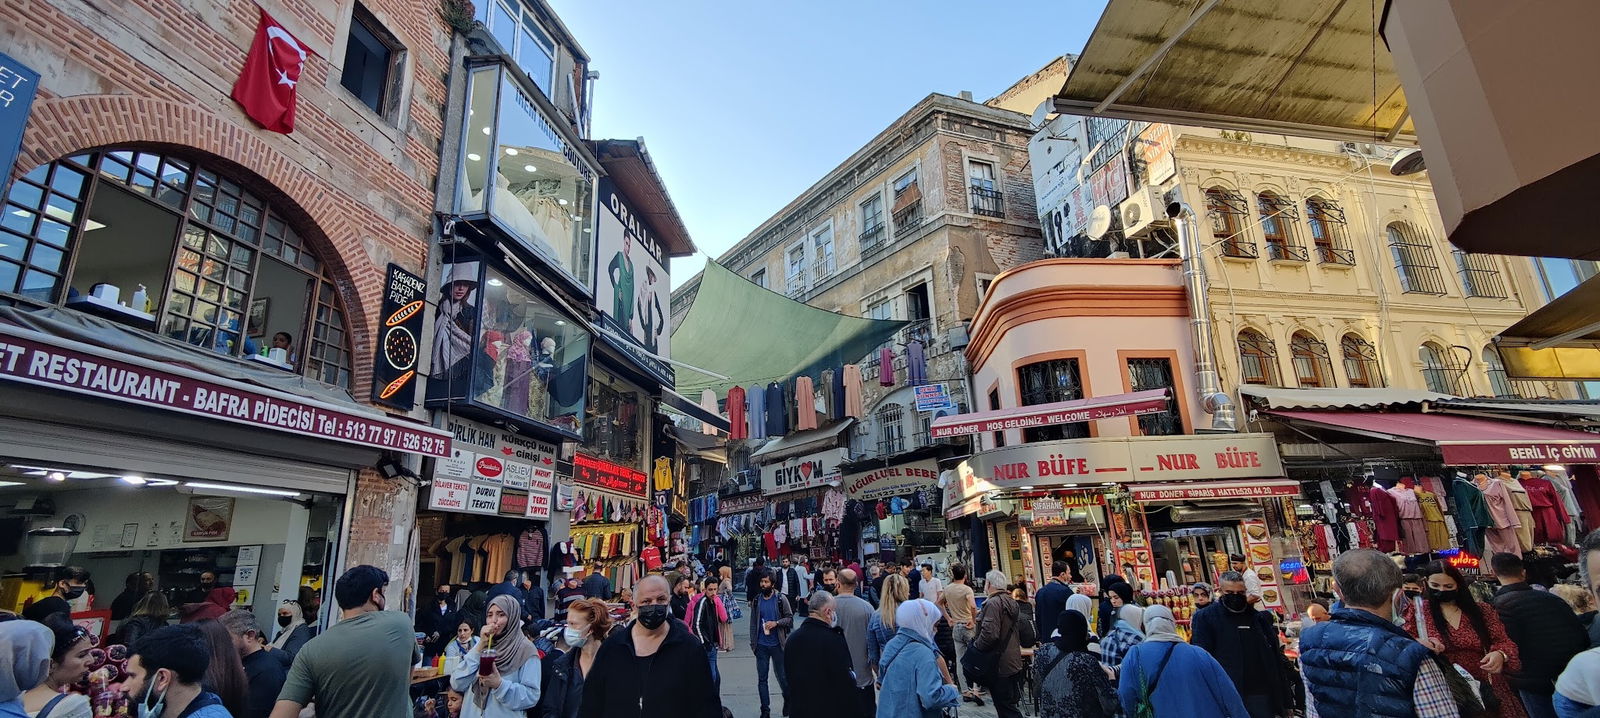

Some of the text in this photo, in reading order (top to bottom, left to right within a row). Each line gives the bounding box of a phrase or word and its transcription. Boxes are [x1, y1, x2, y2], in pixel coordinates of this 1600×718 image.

[563, 142, 592, 185] COUTURE
[610, 192, 662, 264] ORALLAR
[391, 280, 414, 299] BAFRA
[28, 350, 181, 404] RESTAURANT
[193, 387, 249, 419] BAFRA
[253, 398, 315, 431] PİDECİSİ
[318, 414, 336, 435] Tel
[345, 421, 366, 440] 513
[368, 425, 382, 442] 77
[384, 428, 396, 445] 97
[403, 433, 420, 450] 526
[422, 437, 433, 452] 52
[434, 439, 445, 454] 75
[936, 428, 952, 436] NUR
[953, 425, 979, 435] DÖNER
[1005, 415, 1043, 428] GELDİNİZ
[1047, 411, 1091, 424] WELCOME
[478, 430, 496, 449] HAN
[538, 443, 555, 455] HAN
[516, 449, 541, 463] GİRİŞİ
[1156, 446, 1262, 471] NUR BÜFE
[1509, 445, 1597, 461] BERİL İÇ GİYİM
[992, 454, 1090, 481] NUR BÜFE
[848, 467, 902, 494] UĞURLUEL
[905, 468, 937, 480] BEBE
[475, 486, 496, 497] DURUL
[655, 494, 666, 506] 10
[1140, 491, 1156, 499] NUR
[1253, 487, 1262, 495] 44
[1263, 486, 1272, 495] 20
[471, 499, 496, 511] TEKSTİL
